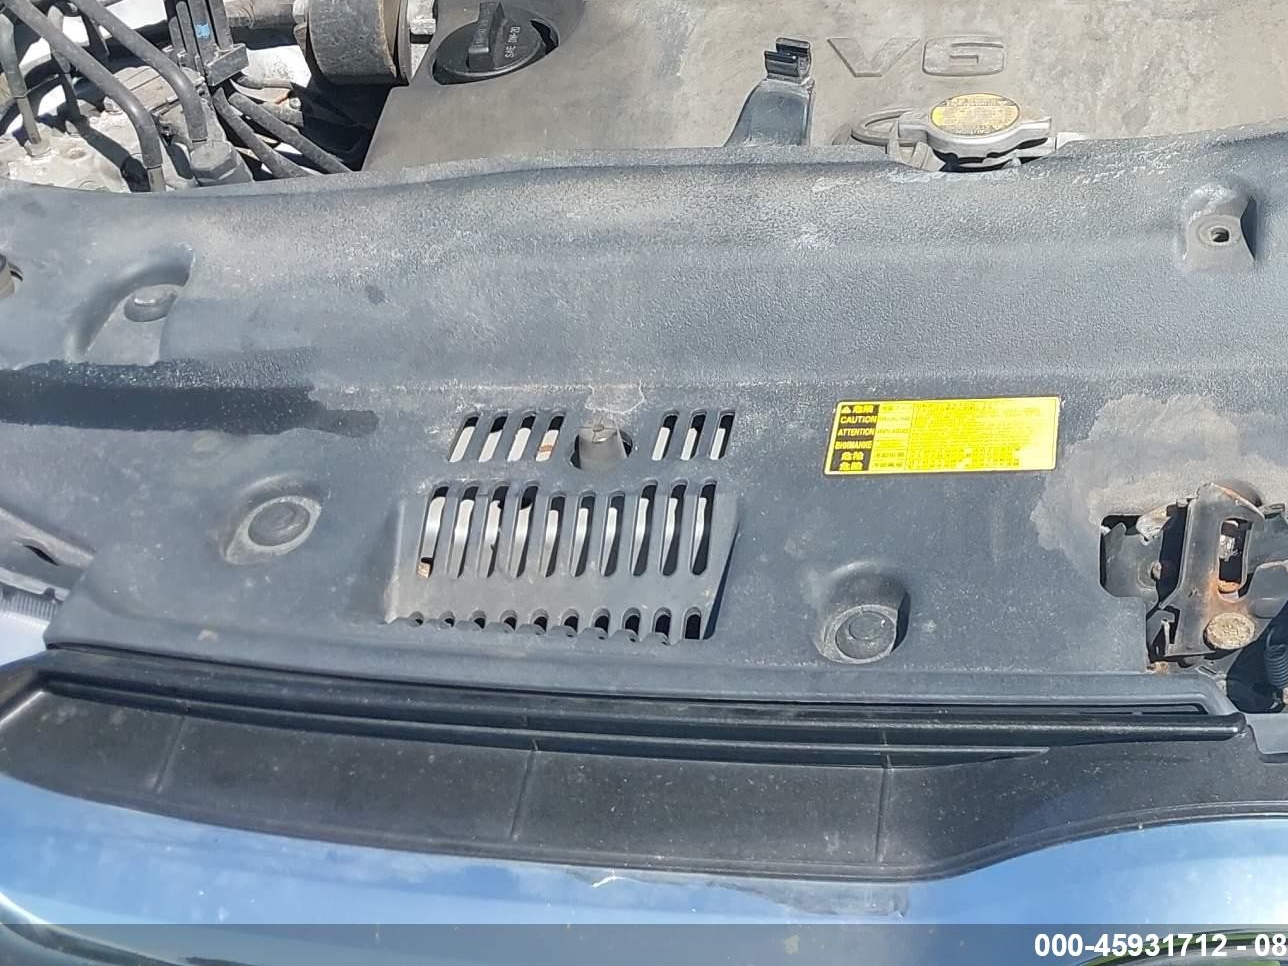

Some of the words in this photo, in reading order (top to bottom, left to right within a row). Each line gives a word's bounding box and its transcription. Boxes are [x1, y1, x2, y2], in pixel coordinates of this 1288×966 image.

[827, 36, 1005, 77] V6
[840, 415, 877, 424] CAUTION
[837, 428, 875, 437] ATTENTION
